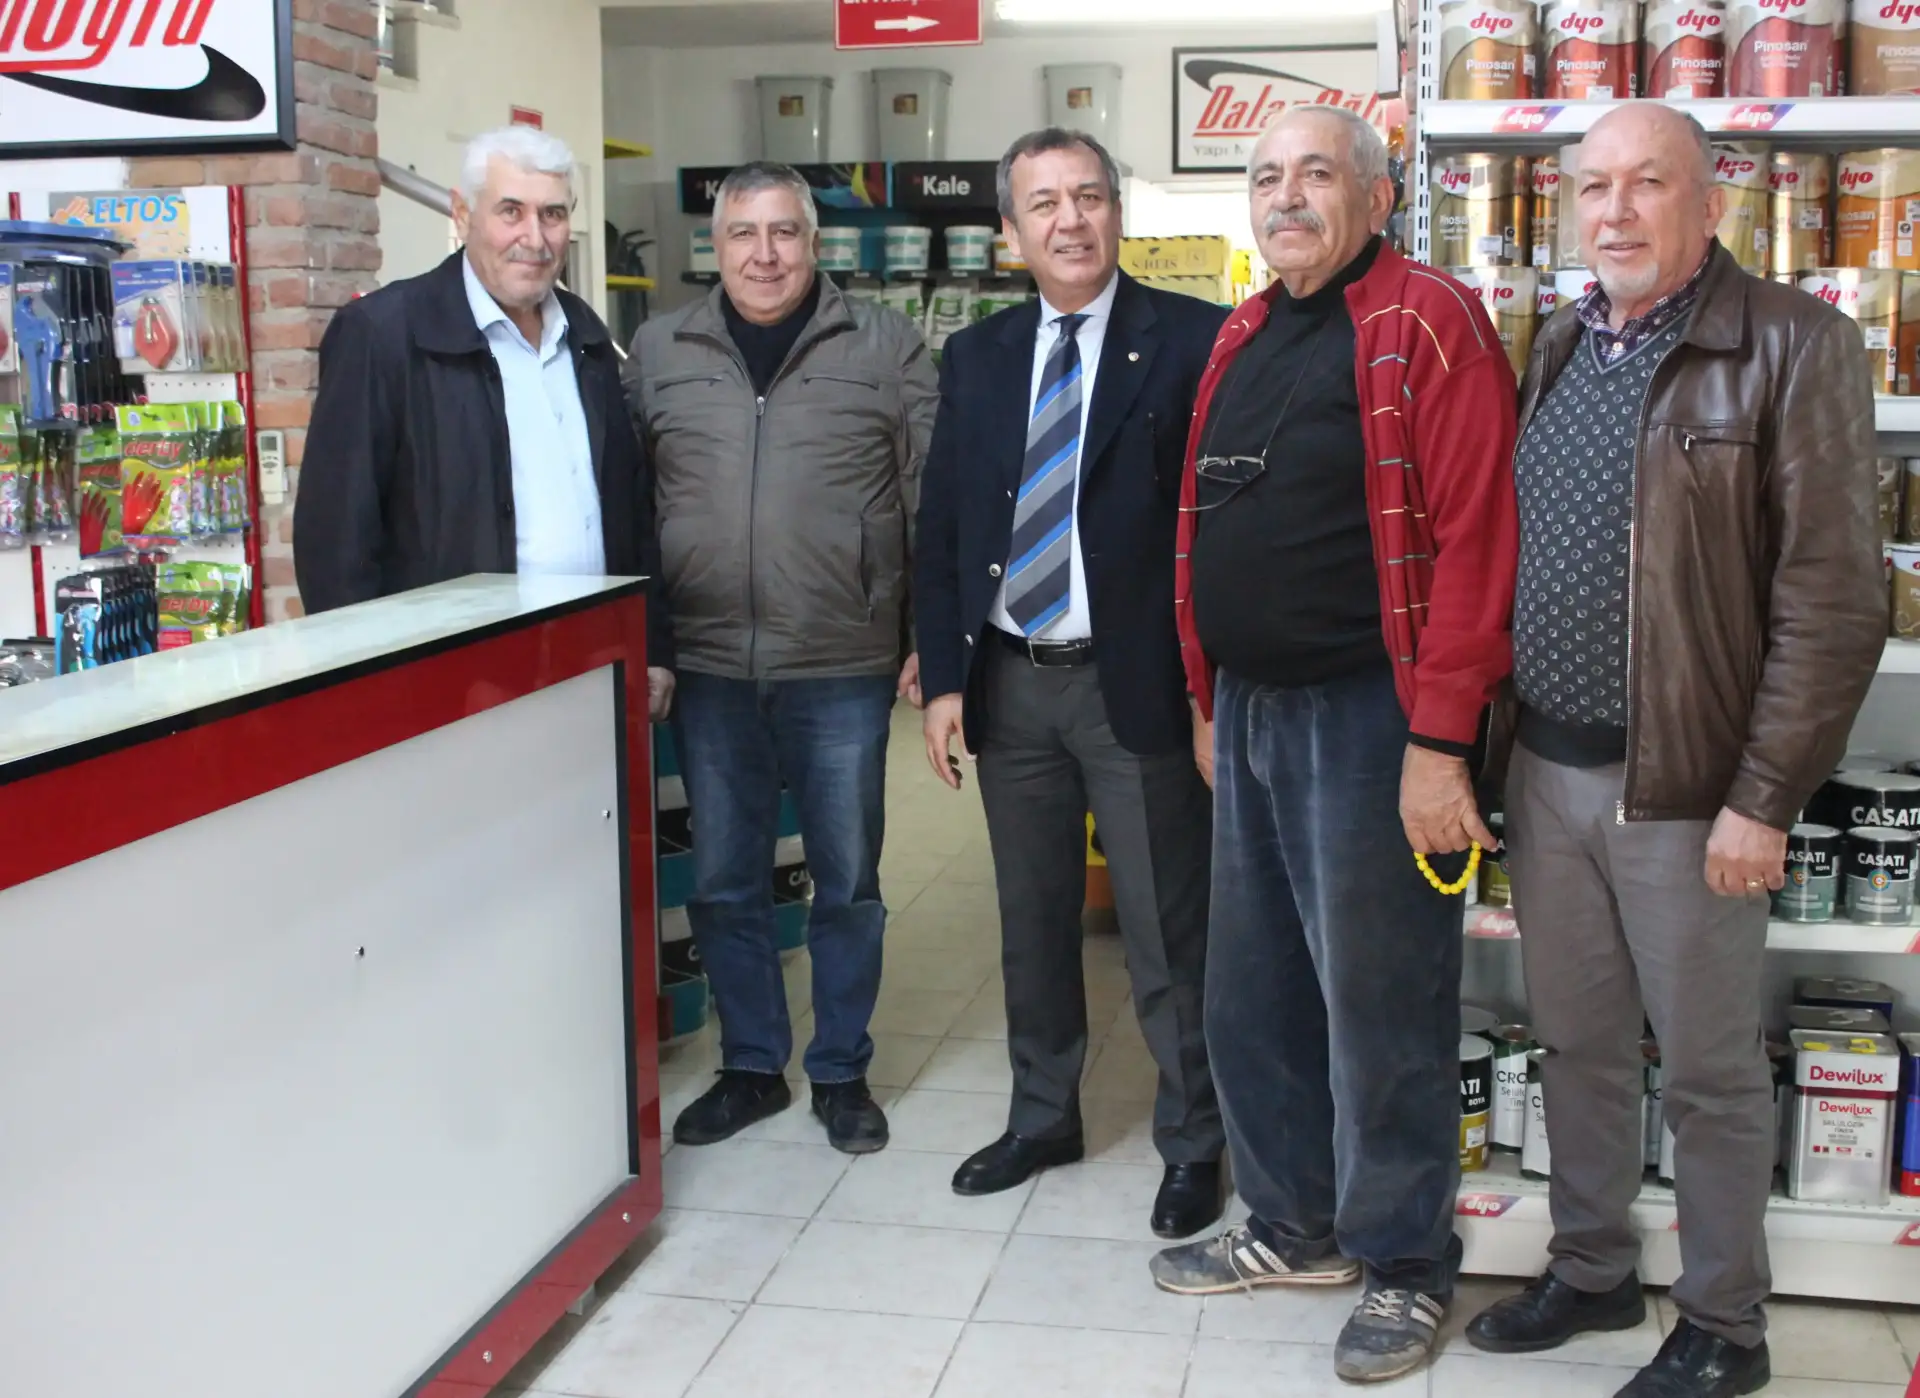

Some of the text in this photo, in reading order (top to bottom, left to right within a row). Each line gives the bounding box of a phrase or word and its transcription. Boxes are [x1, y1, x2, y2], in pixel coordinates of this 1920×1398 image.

[1470, 12, 1513, 34] dyo
[1560, 12, 1604, 34] dyo
[1676, 9, 1721, 32] dyo
[1754, 40, 1807, 53] Pinosan
[1466, 59, 1515, 71] Pinosan
[1556, 59, 1605, 71] Pinosan
[1671, 57, 1721, 69] Pinosan
[1507, 108, 1544, 129] dyo
[1735, 107, 1773, 127] dyo
[923, 177, 970, 196] Kale
[1440, 168, 1471, 190] dyo
[1768, 170, 1799, 190] yo
[1840, 167, 1873, 190] dyo
[93, 195, 179, 225] ELTOS
[125, 439, 184, 459] derby
[1787, 851, 1826, 864] ASATI
[1857, 852, 1905, 867] CASATI
[1809, 1065, 1884, 1085] Dewilux
[1819, 1100, 1874, 1116] Dewilux
[1464, 1196, 1502, 1215] dyo
